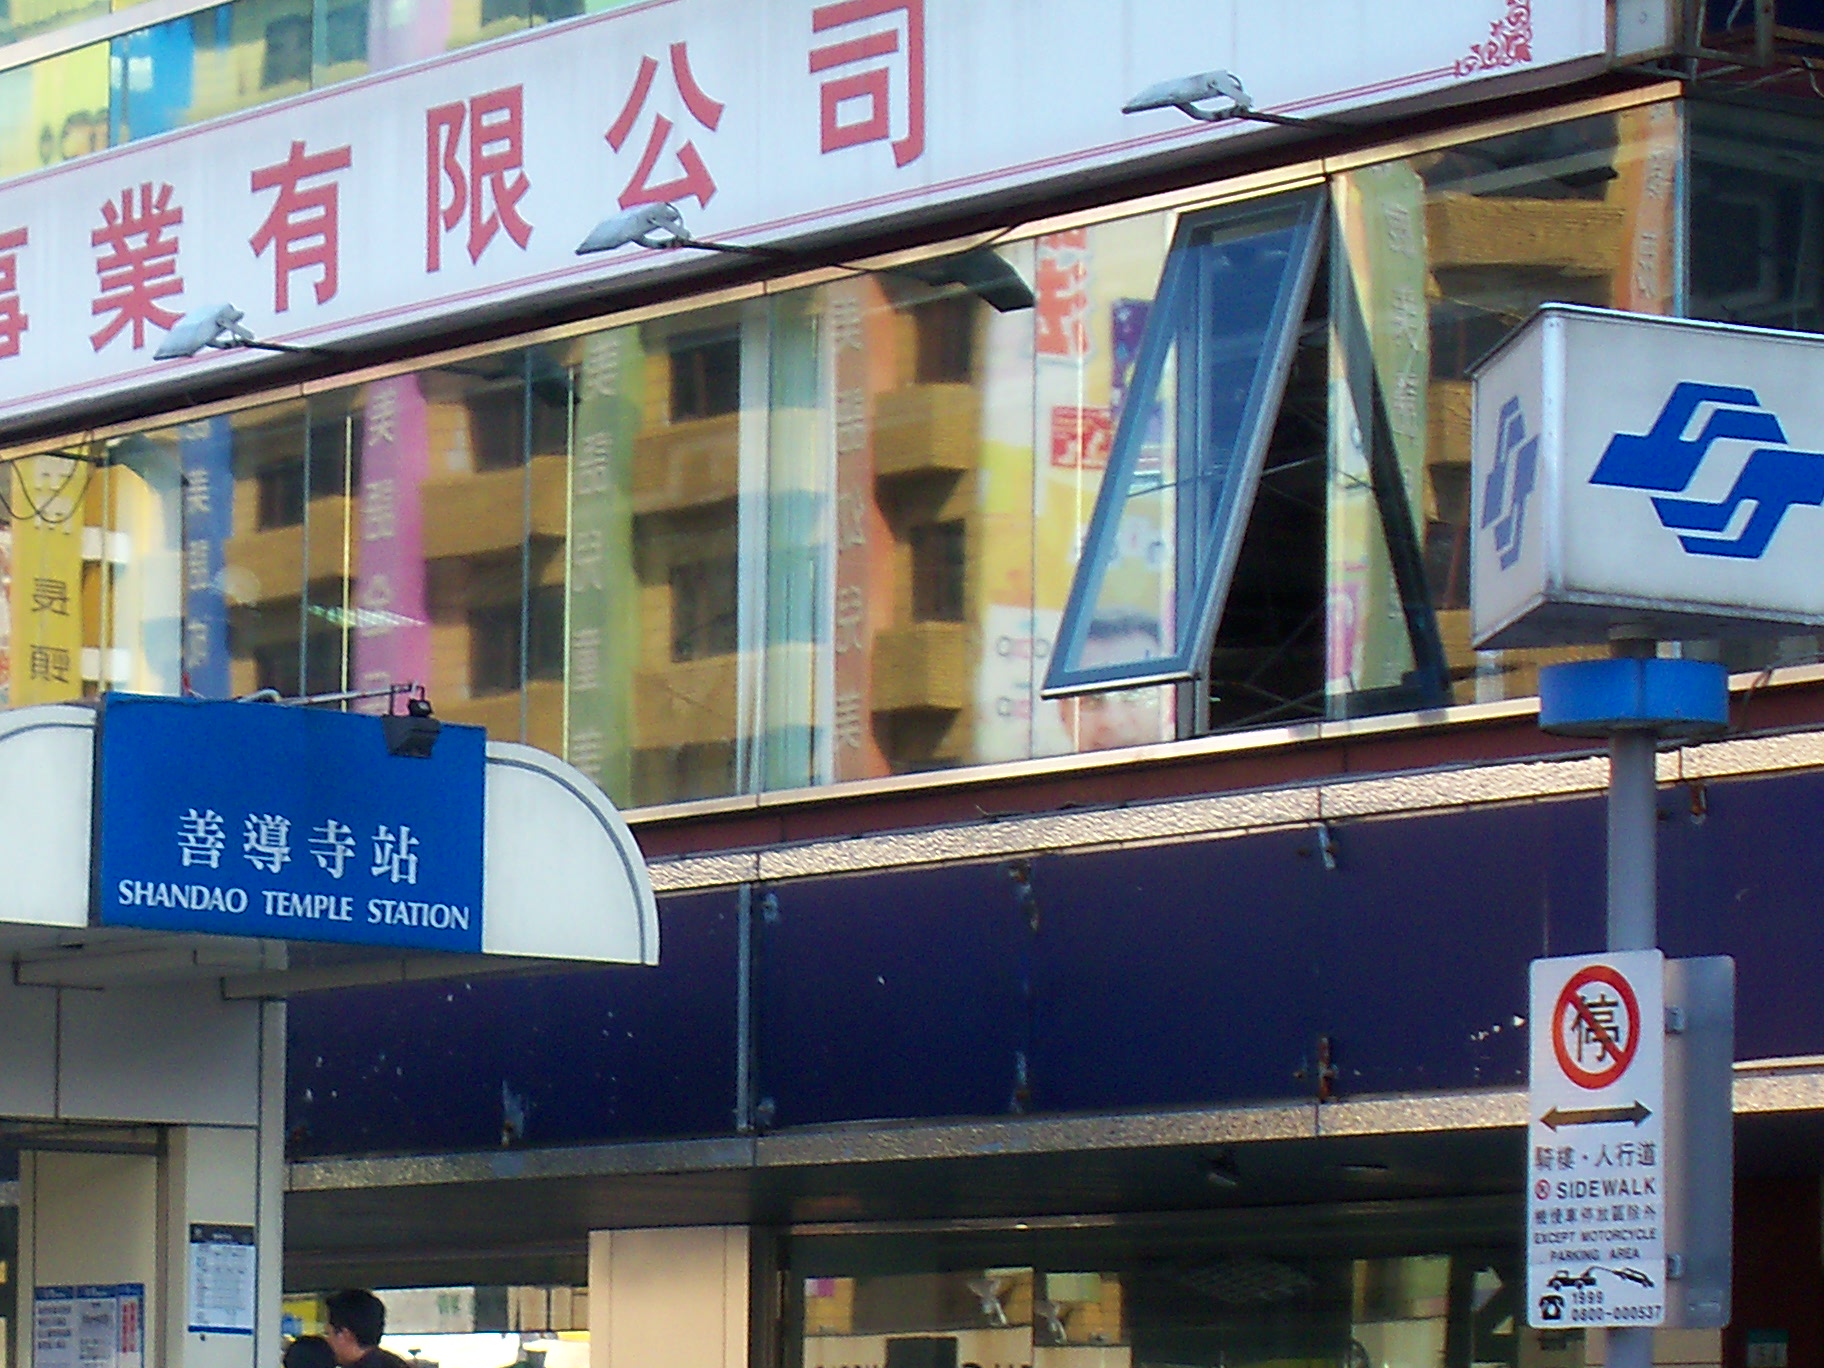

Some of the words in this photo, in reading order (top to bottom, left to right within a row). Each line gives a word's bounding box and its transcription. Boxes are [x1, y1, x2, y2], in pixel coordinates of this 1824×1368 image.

[177, 807, 420, 885] 善導寺站
[118, 879, 247, 914] SHANDAO
[262, 890, 354, 922] TEMPLE
[367, 899, 470, 931] STATION
[1557, 1177, 1656, 1199] SIDEWALK
